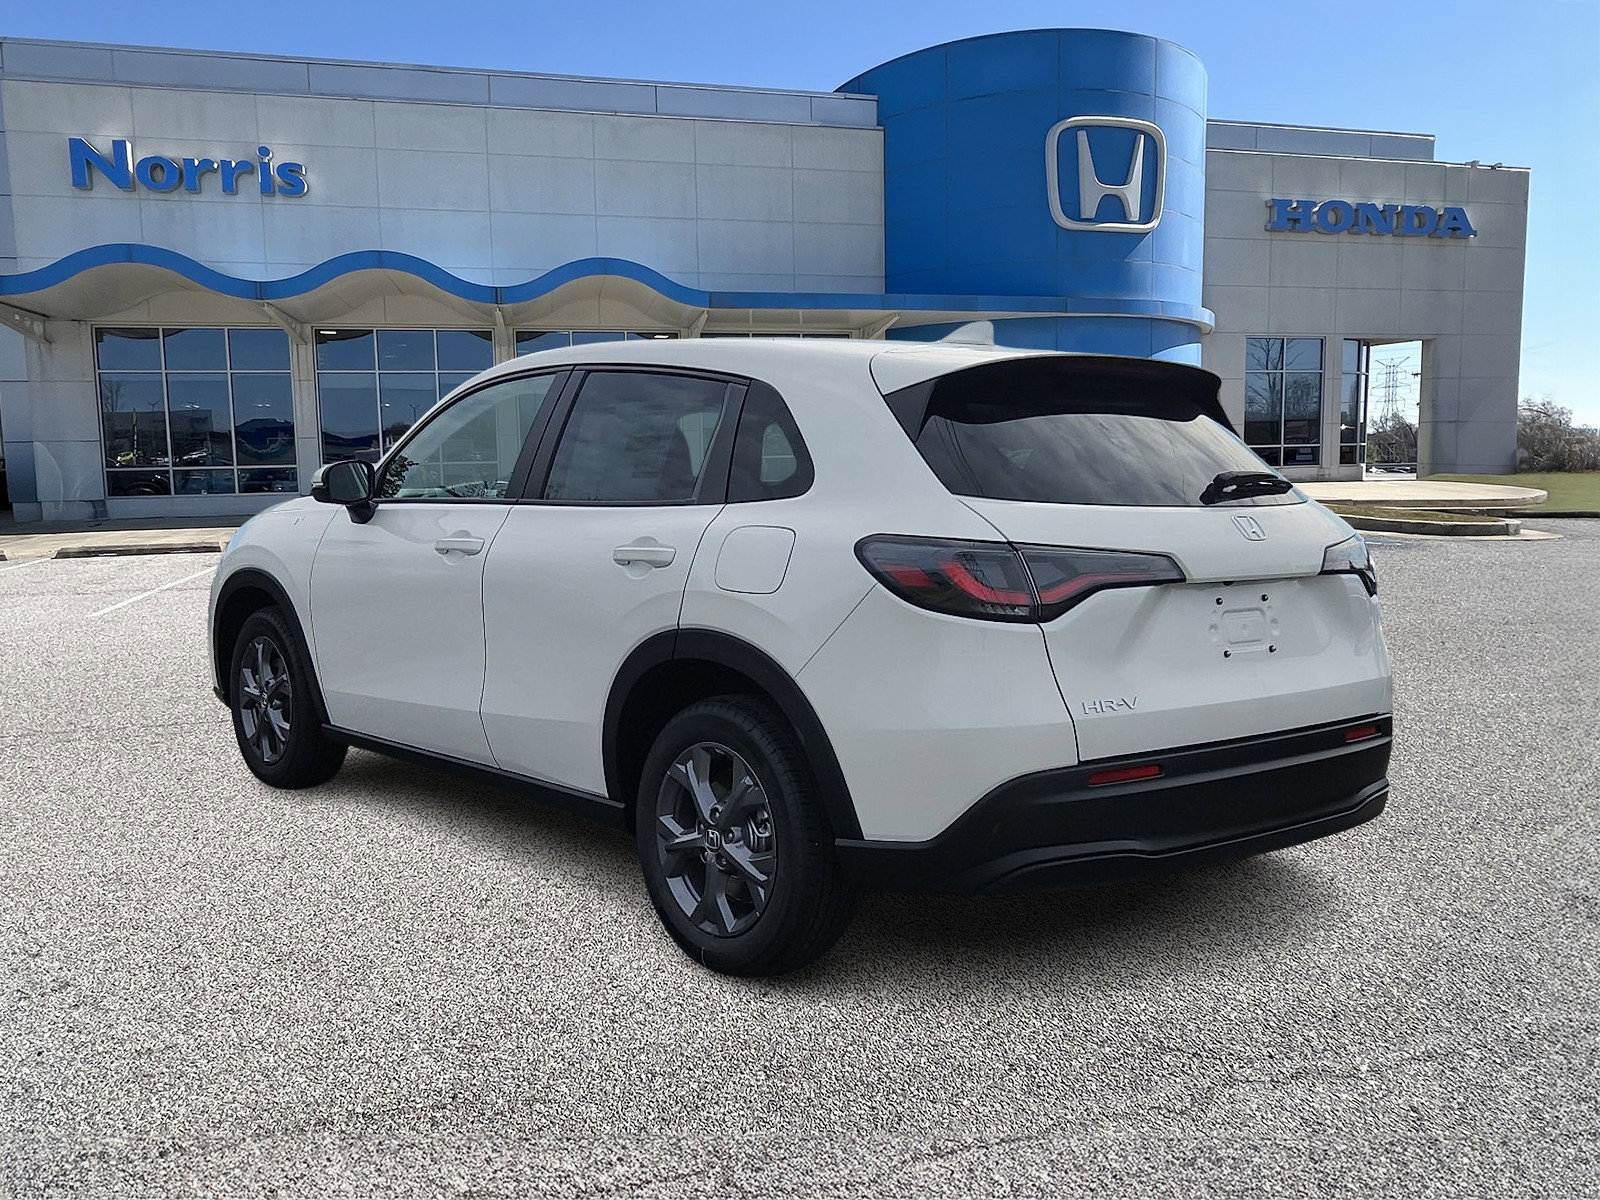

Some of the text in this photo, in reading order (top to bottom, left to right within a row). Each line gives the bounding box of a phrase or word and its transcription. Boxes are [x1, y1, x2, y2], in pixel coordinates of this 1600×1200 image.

[69, 138, 308, 197] Norris
[1265, 198, 1477, 239] HONDA
[1081, 696, 1138, 715] HR-V
